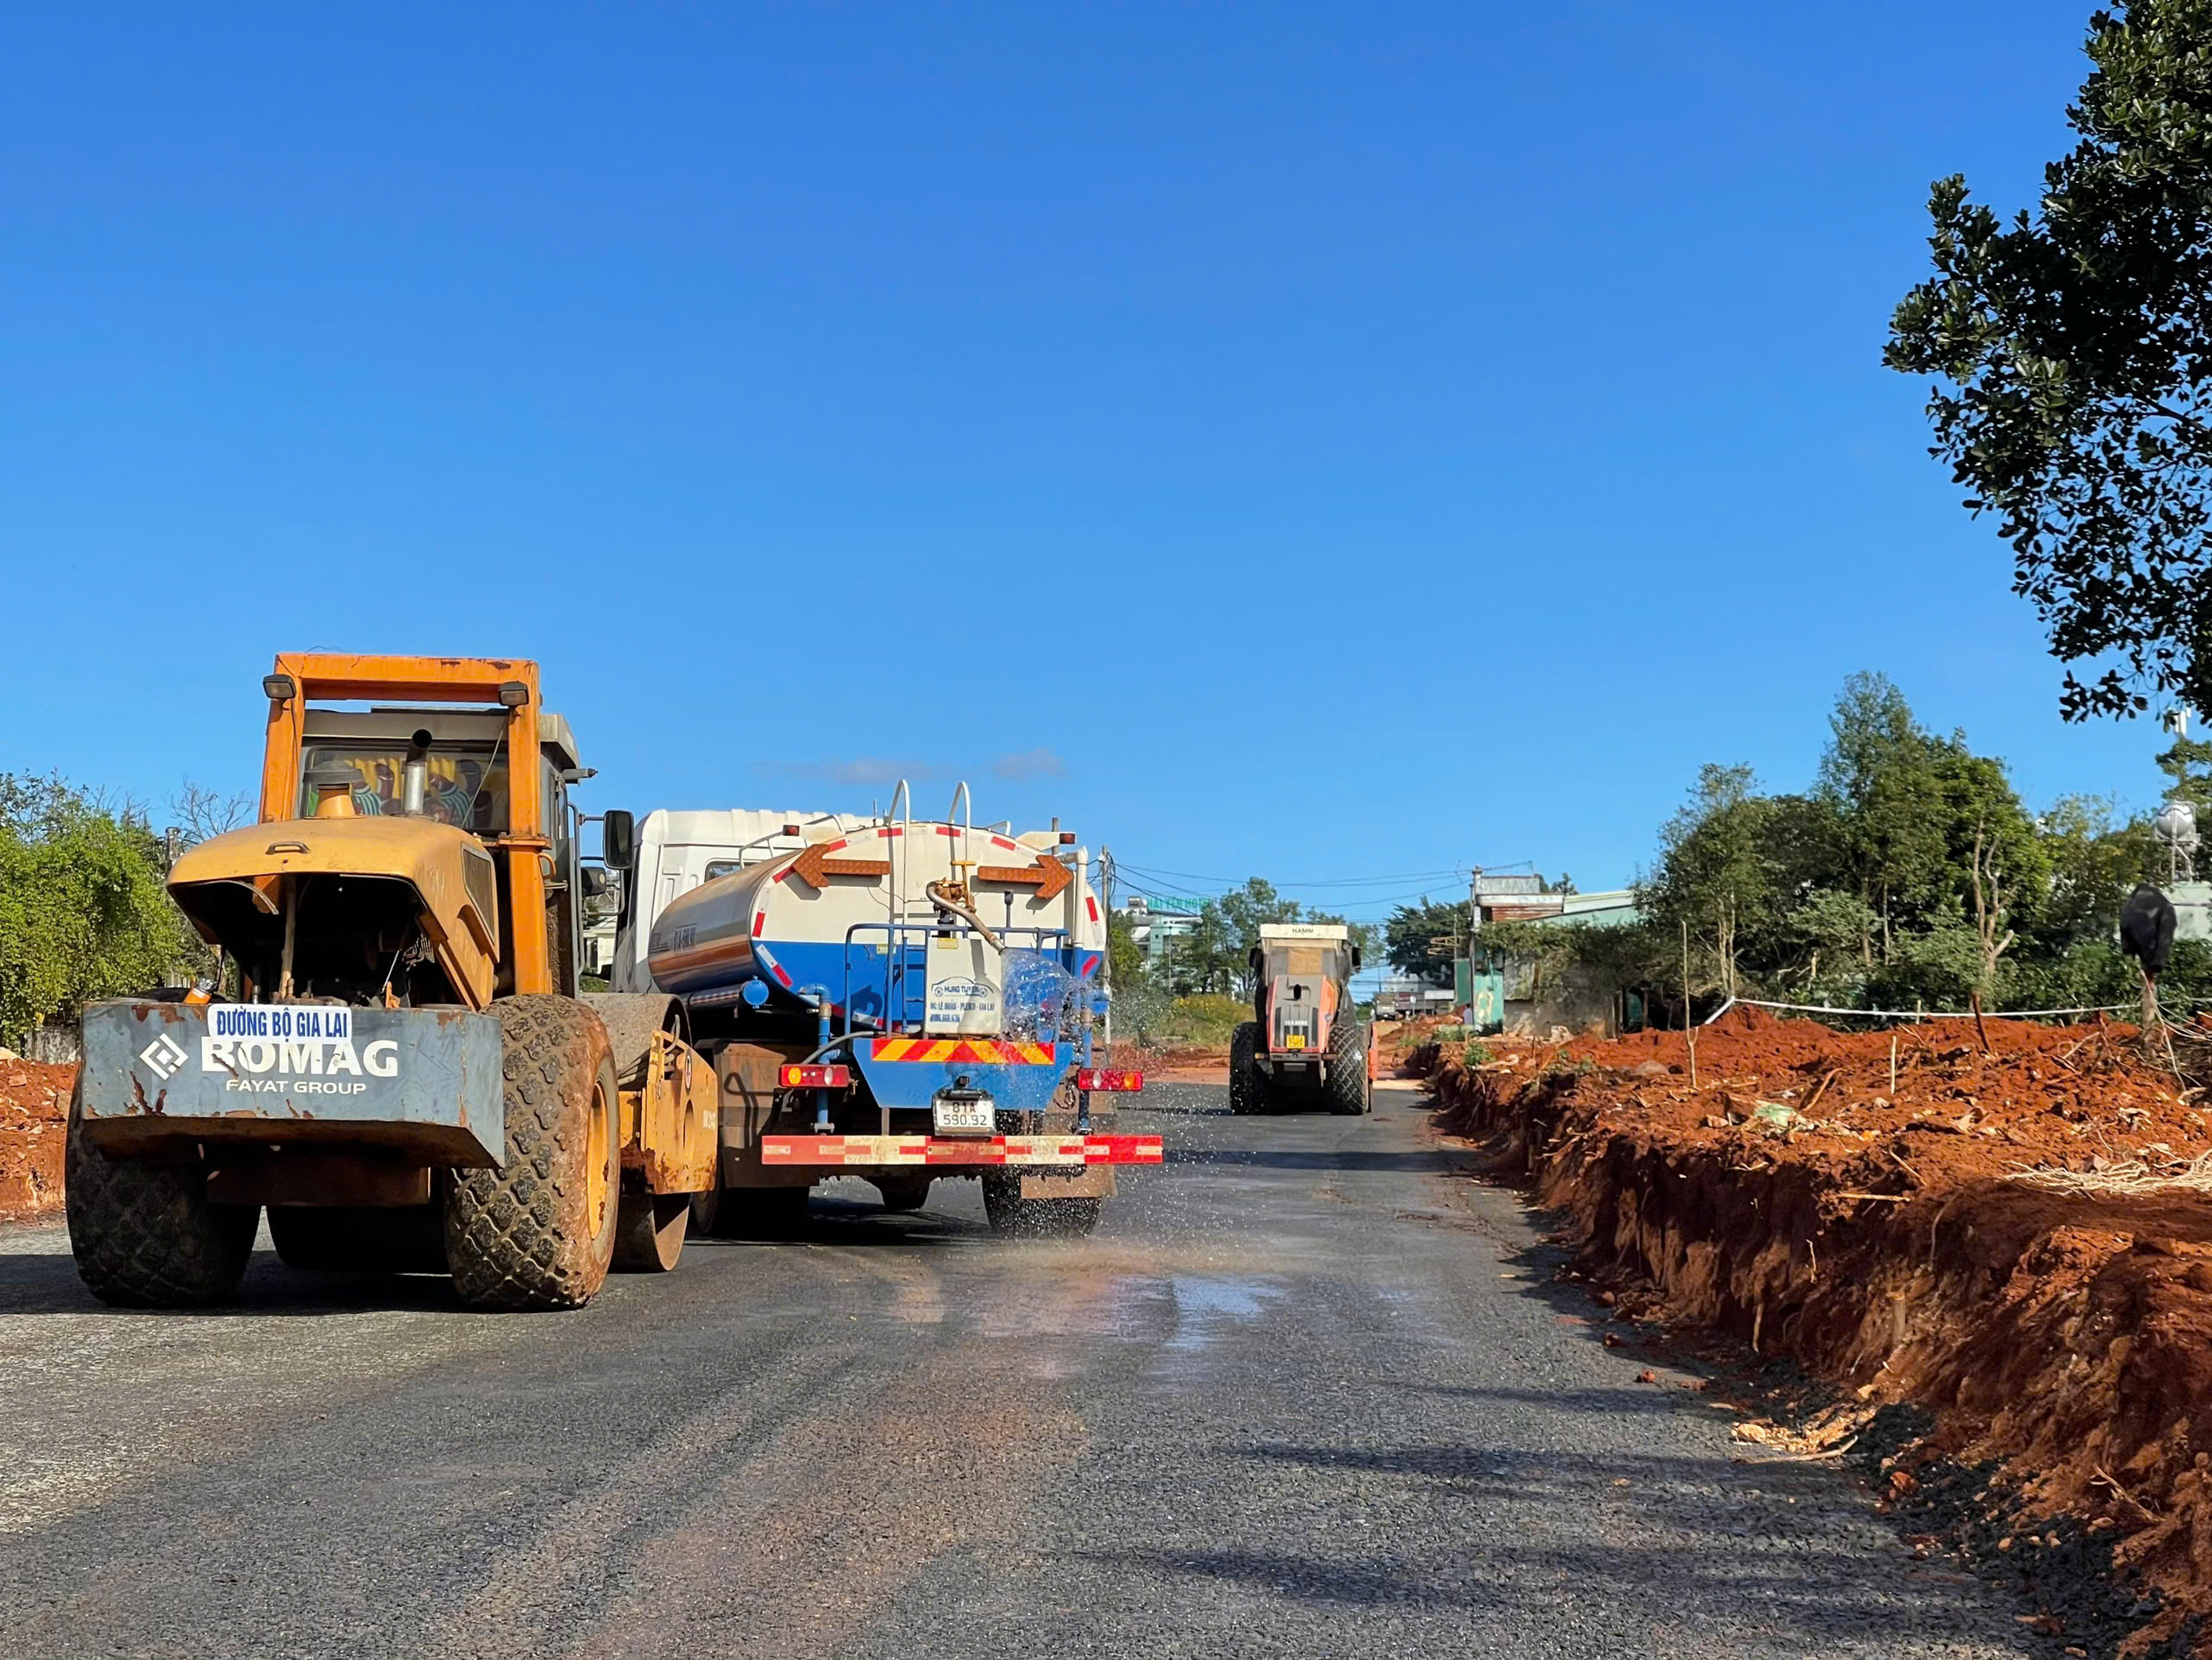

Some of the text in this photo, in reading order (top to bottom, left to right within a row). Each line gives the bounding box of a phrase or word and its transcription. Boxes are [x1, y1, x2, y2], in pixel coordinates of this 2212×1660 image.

[217, 1006, 348, 1043] ĐƯỜNG BỘ GIA LAI
[201, 1035, 399, 1078] BOMAG
[225, 1078, 368, 1095] FAYAT GROUP
[952, 1101, 977, 1113] 81A
[943, 1114, 987, 1126] 590.92
